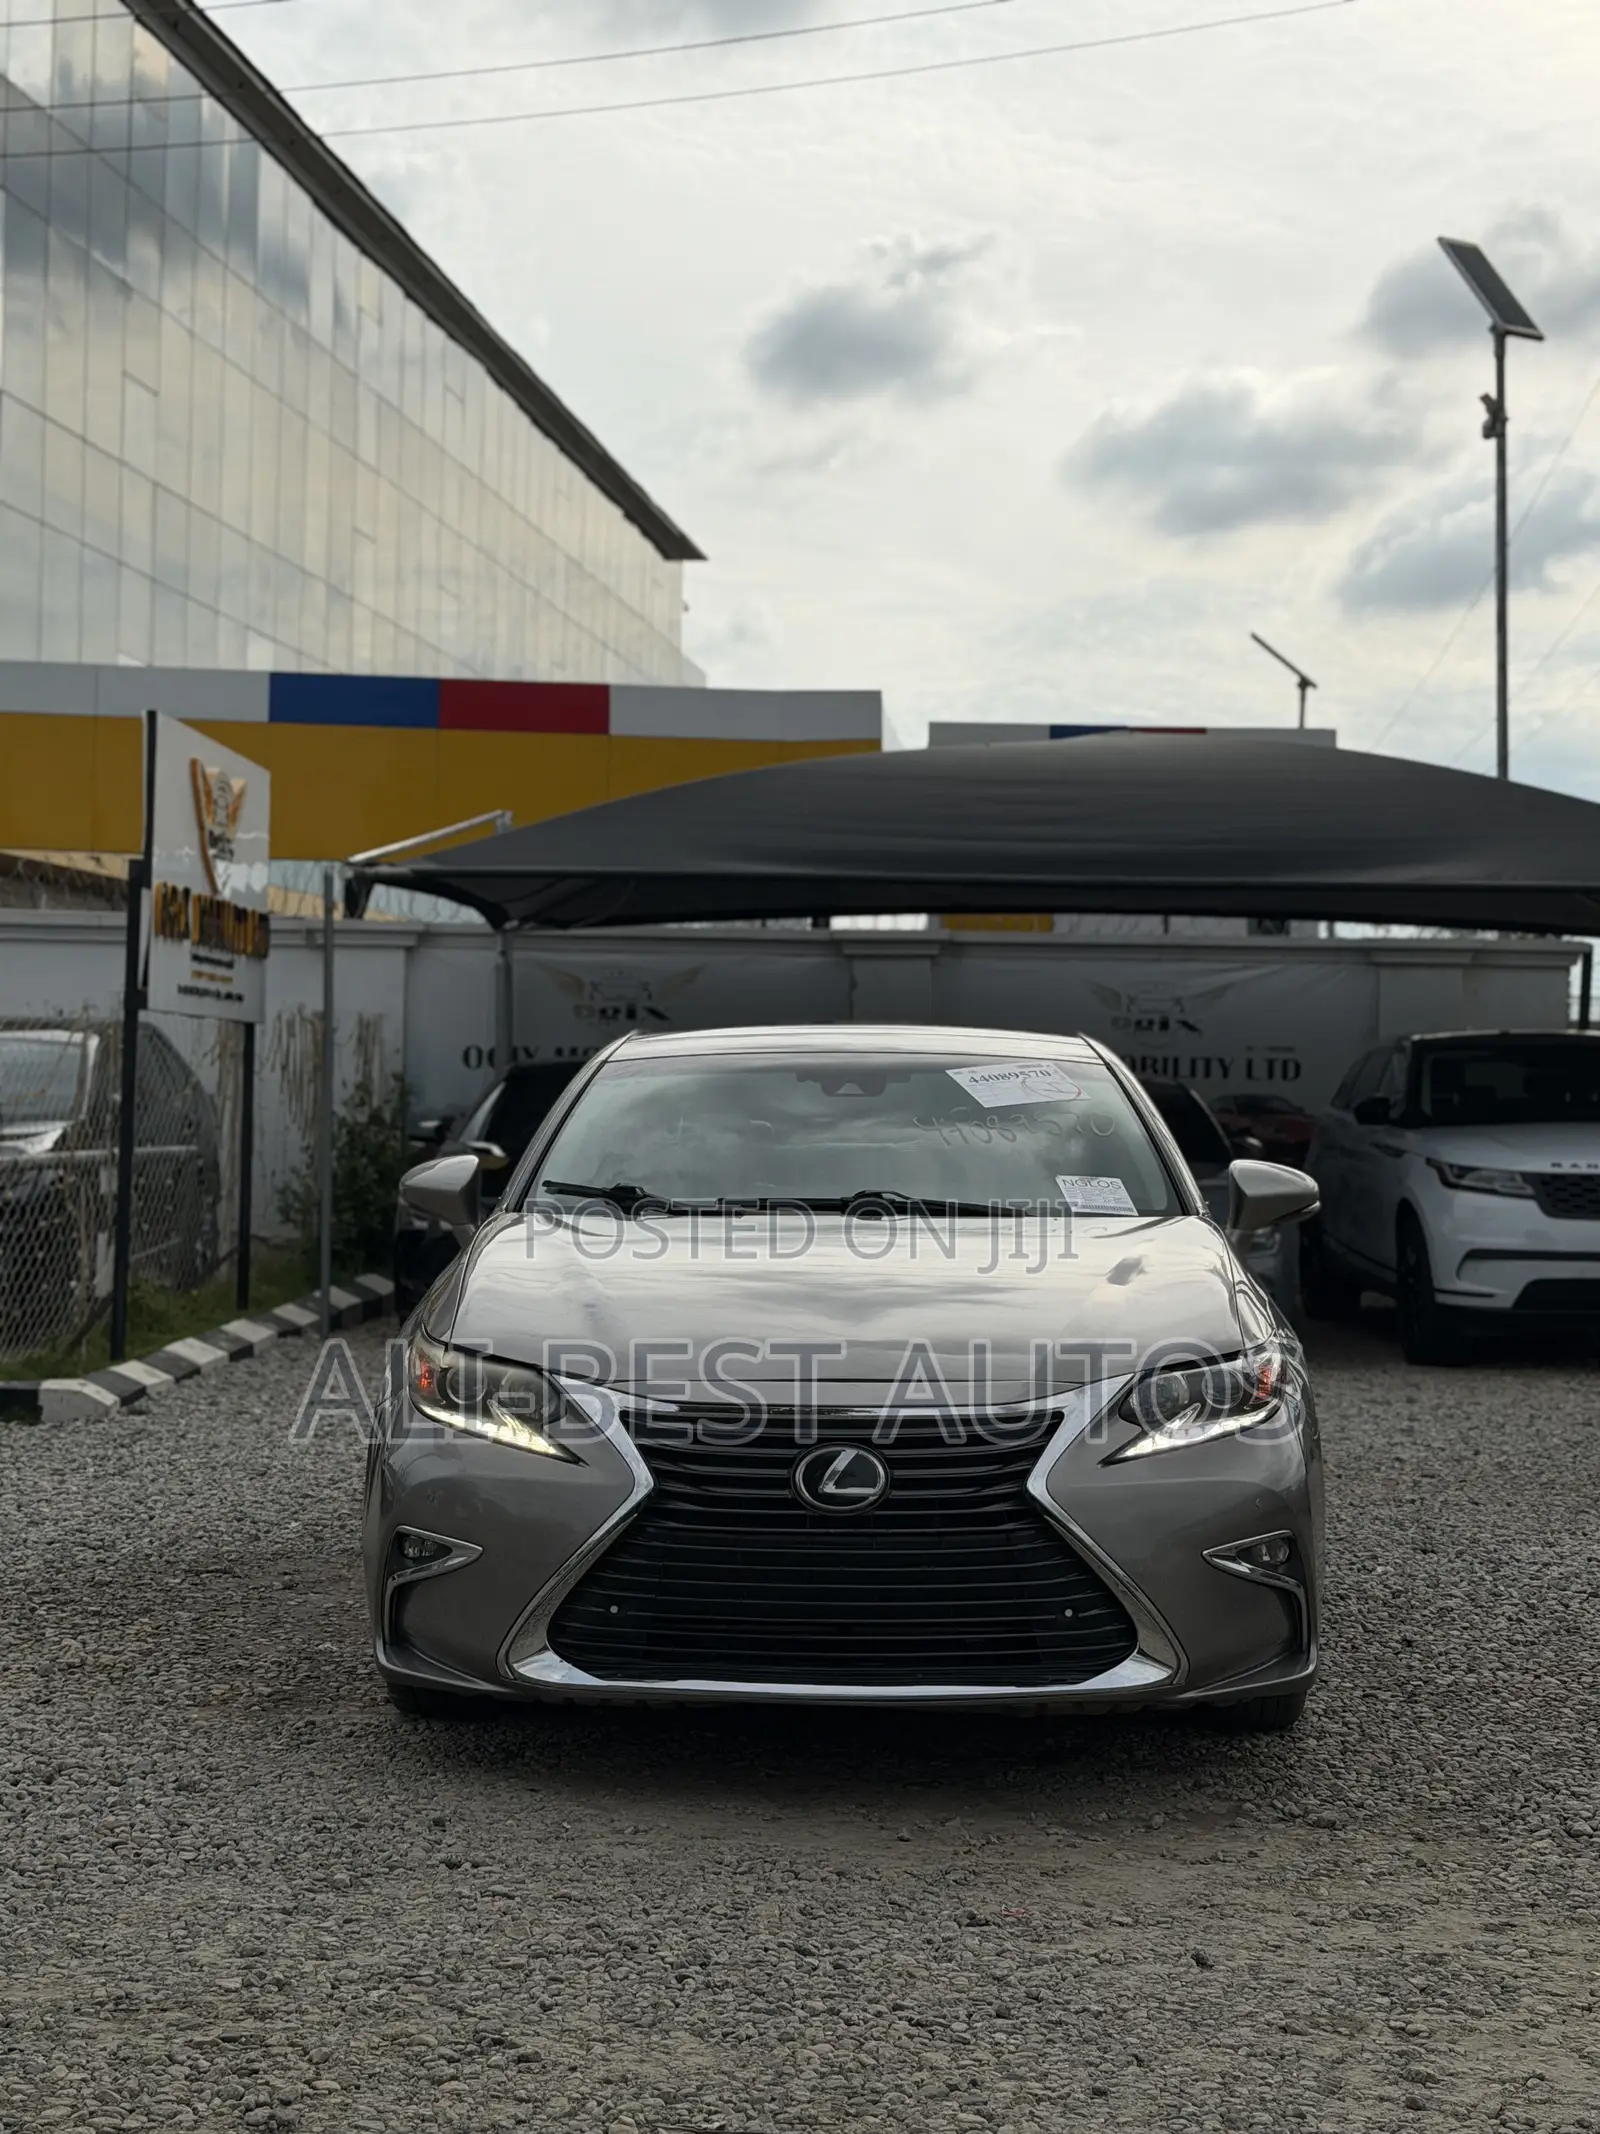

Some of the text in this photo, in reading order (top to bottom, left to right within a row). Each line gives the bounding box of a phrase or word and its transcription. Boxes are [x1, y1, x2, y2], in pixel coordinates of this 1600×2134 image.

[968, 1069, 1052, 1084] 44089570
[1246, 1057, 1301, 1081] LTD
[1061, 1179, 1122, 1190] NGLOS
